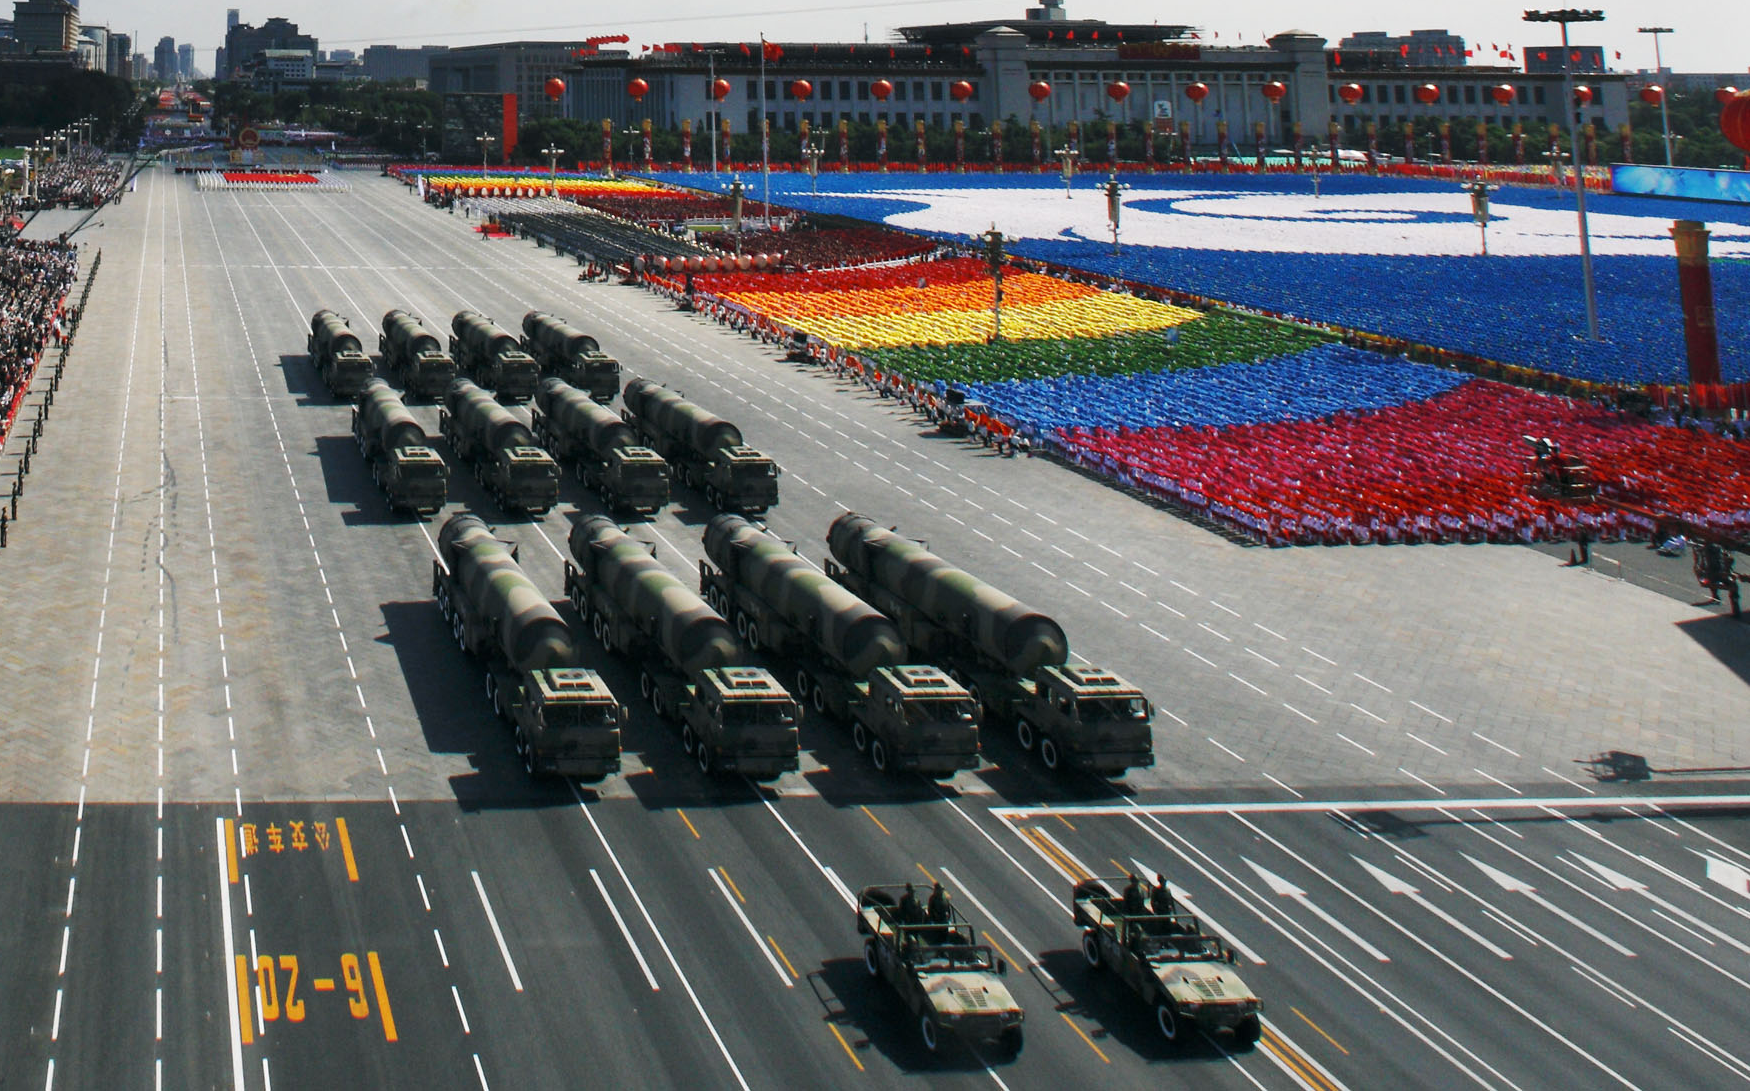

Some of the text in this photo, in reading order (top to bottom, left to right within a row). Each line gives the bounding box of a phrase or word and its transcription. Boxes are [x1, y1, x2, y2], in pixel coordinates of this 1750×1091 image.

[242, 821, 330, 854] 公交车道
[257, 953, 369, 1022] 6-20
